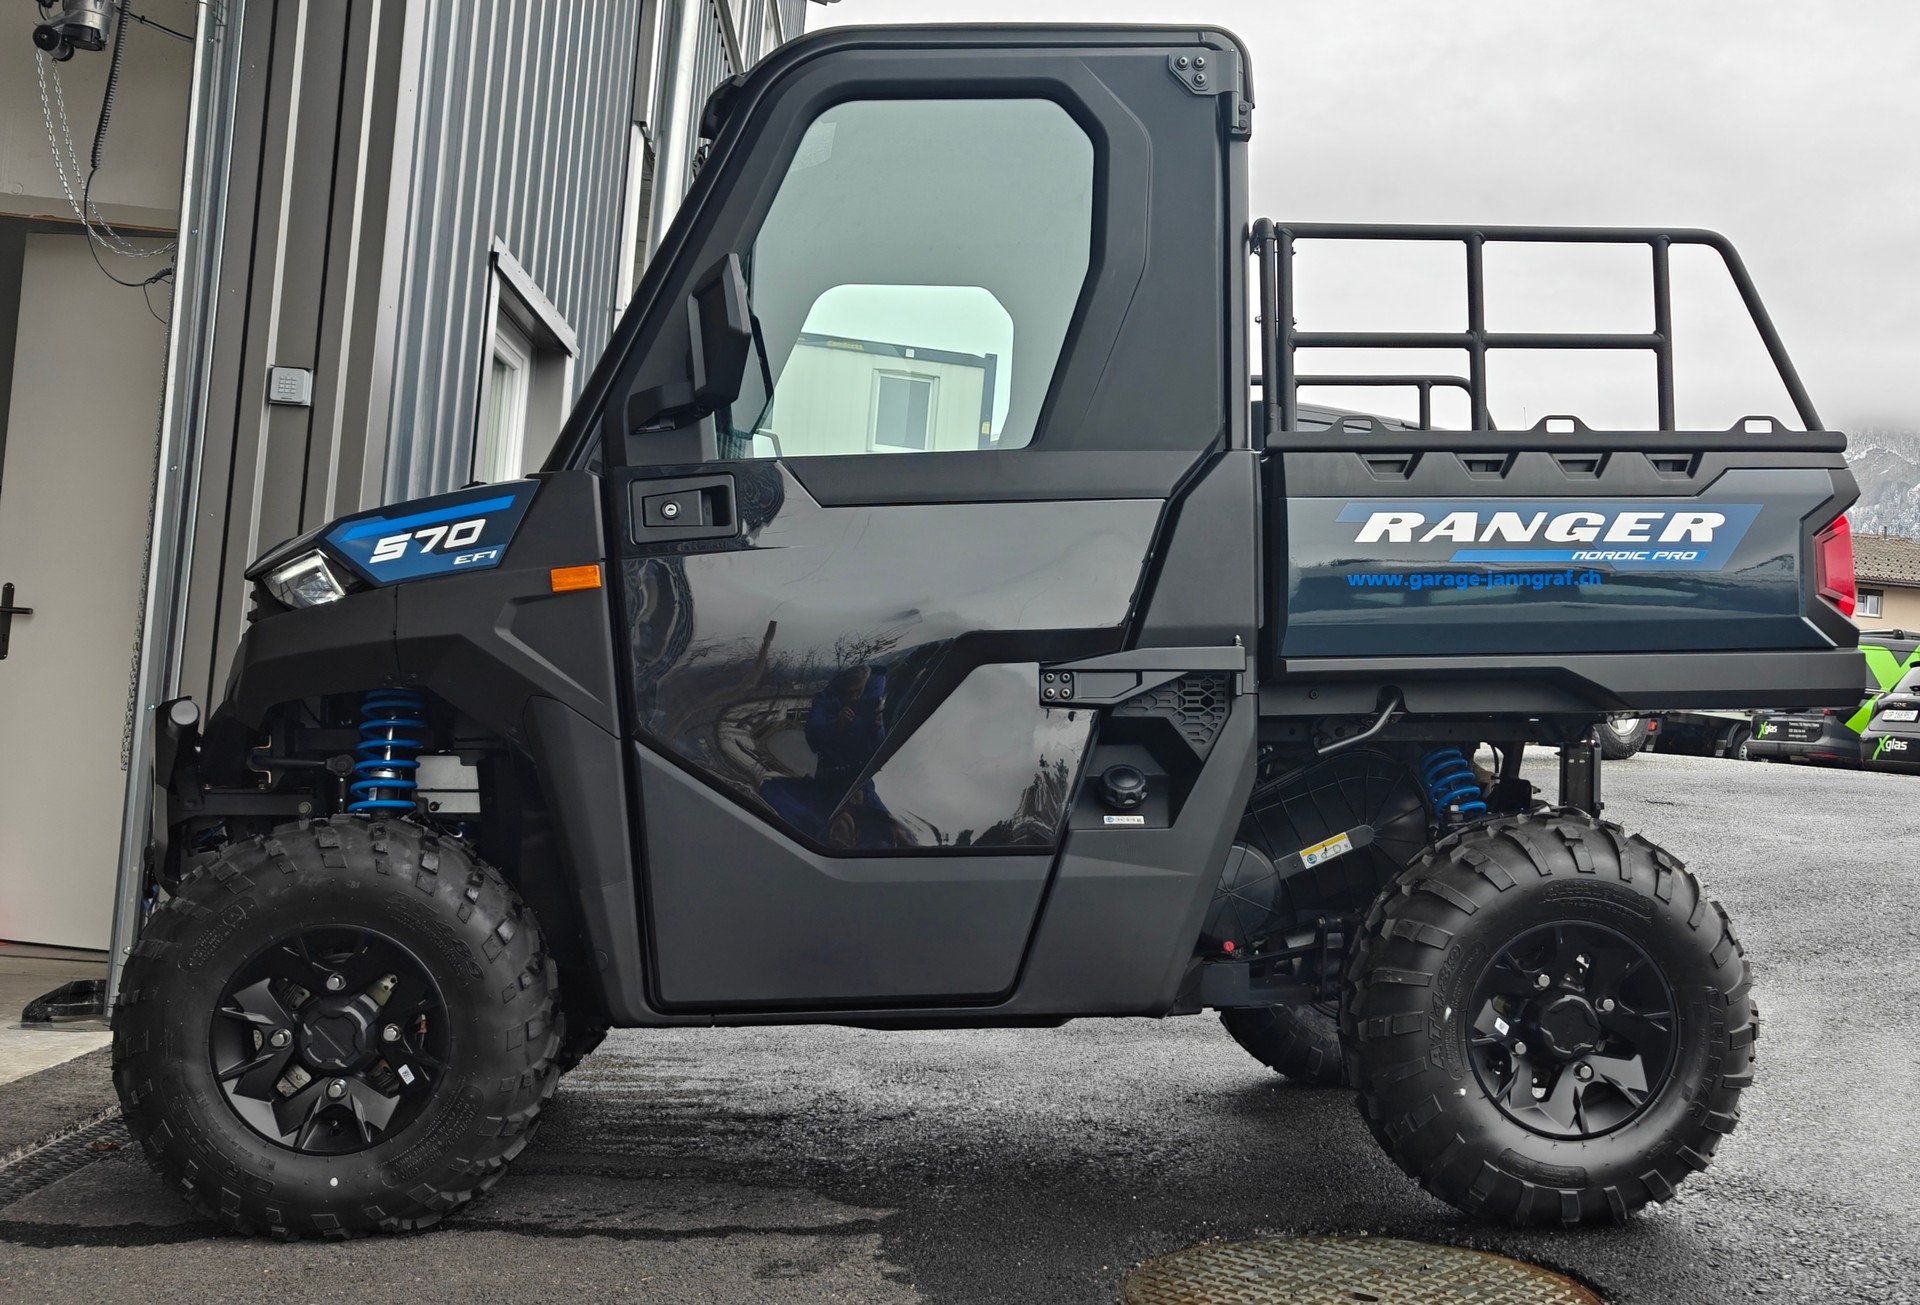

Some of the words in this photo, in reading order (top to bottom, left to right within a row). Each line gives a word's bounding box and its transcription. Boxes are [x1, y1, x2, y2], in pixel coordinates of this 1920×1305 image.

[1354, 512, 1726, 543] RANGER
[369, 518, 487, 564] 570
[453, 549, 498, 565] EFI
[1571, 551, 1650, 561] NORDIC
[1651, 551, 1698, 561] PRO
[1347, 570, 1602, 590] www.garage-janngraf.ch
[1757, 721, 1778, 739] Xglas
[1872, 734, 1908, 760] Xglas
